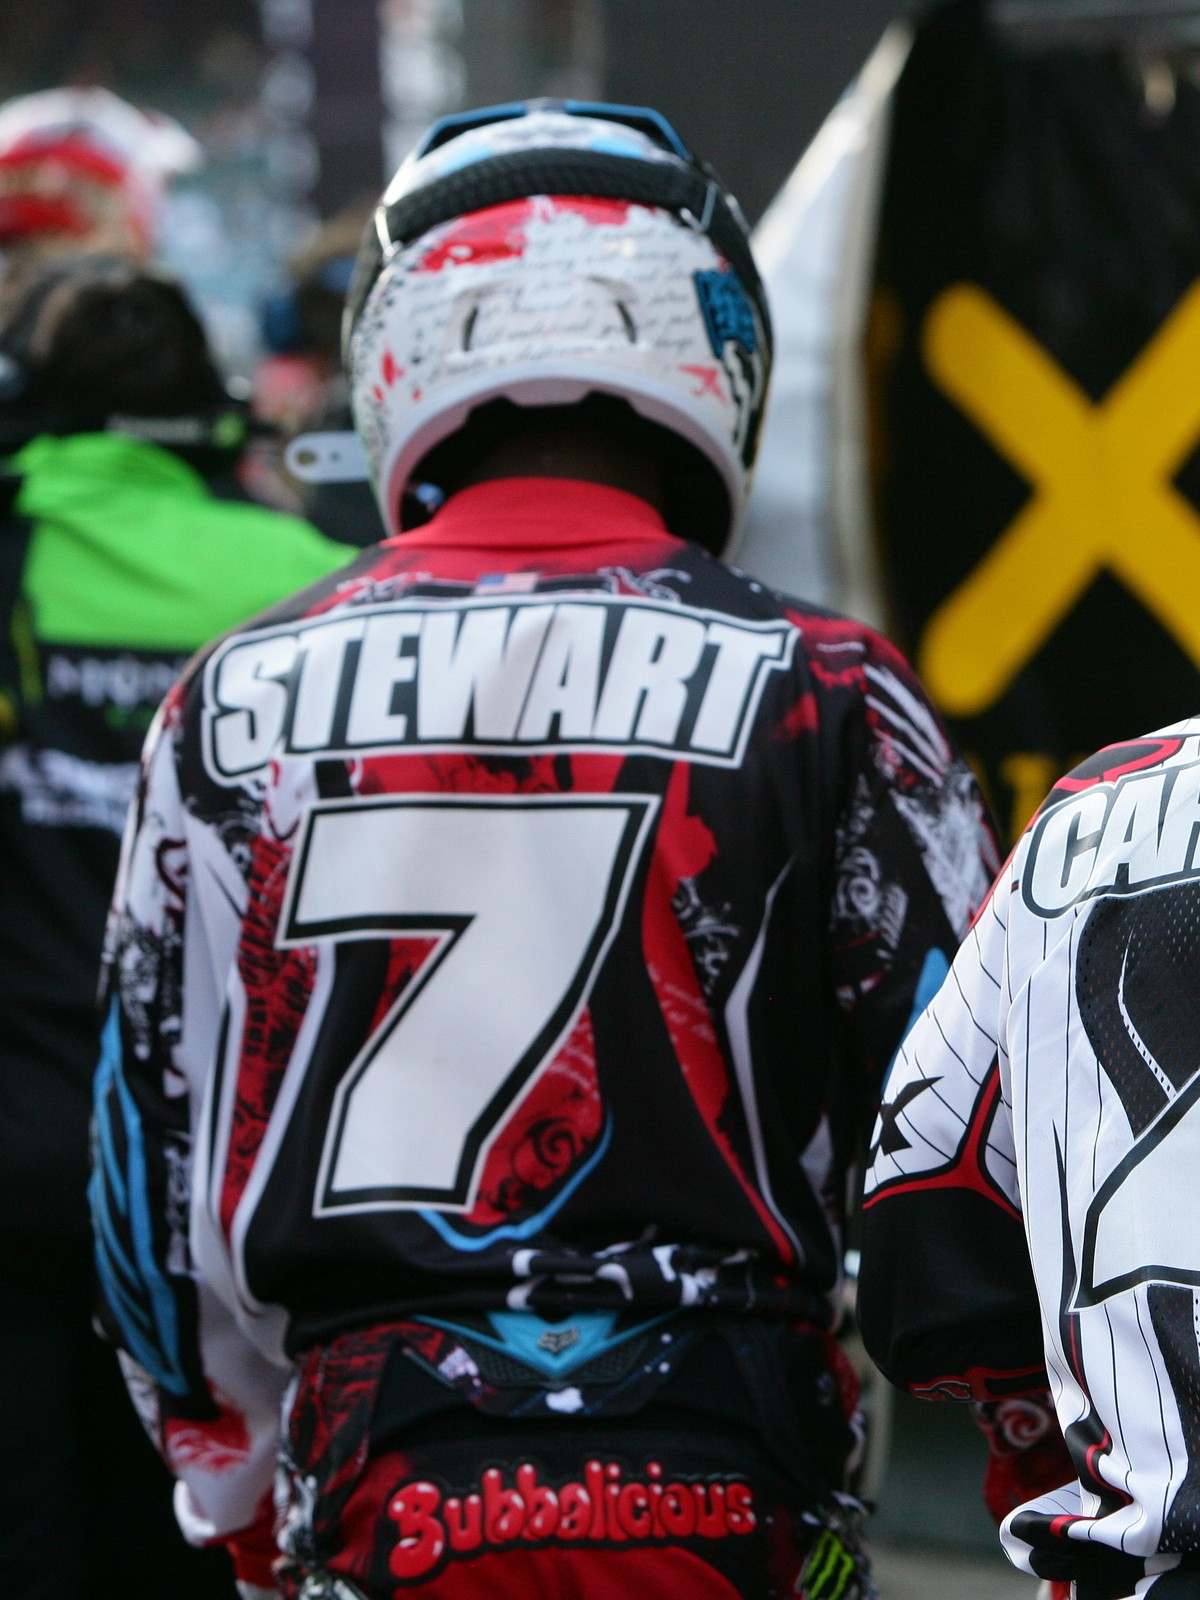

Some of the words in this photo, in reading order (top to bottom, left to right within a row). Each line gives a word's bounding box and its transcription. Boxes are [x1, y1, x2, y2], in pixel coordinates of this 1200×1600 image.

[207, 599, 790, 779] STEWART
[281, 799, 648, 1210] 7
[388, 1460, 757, 1579] Bubbalicious
